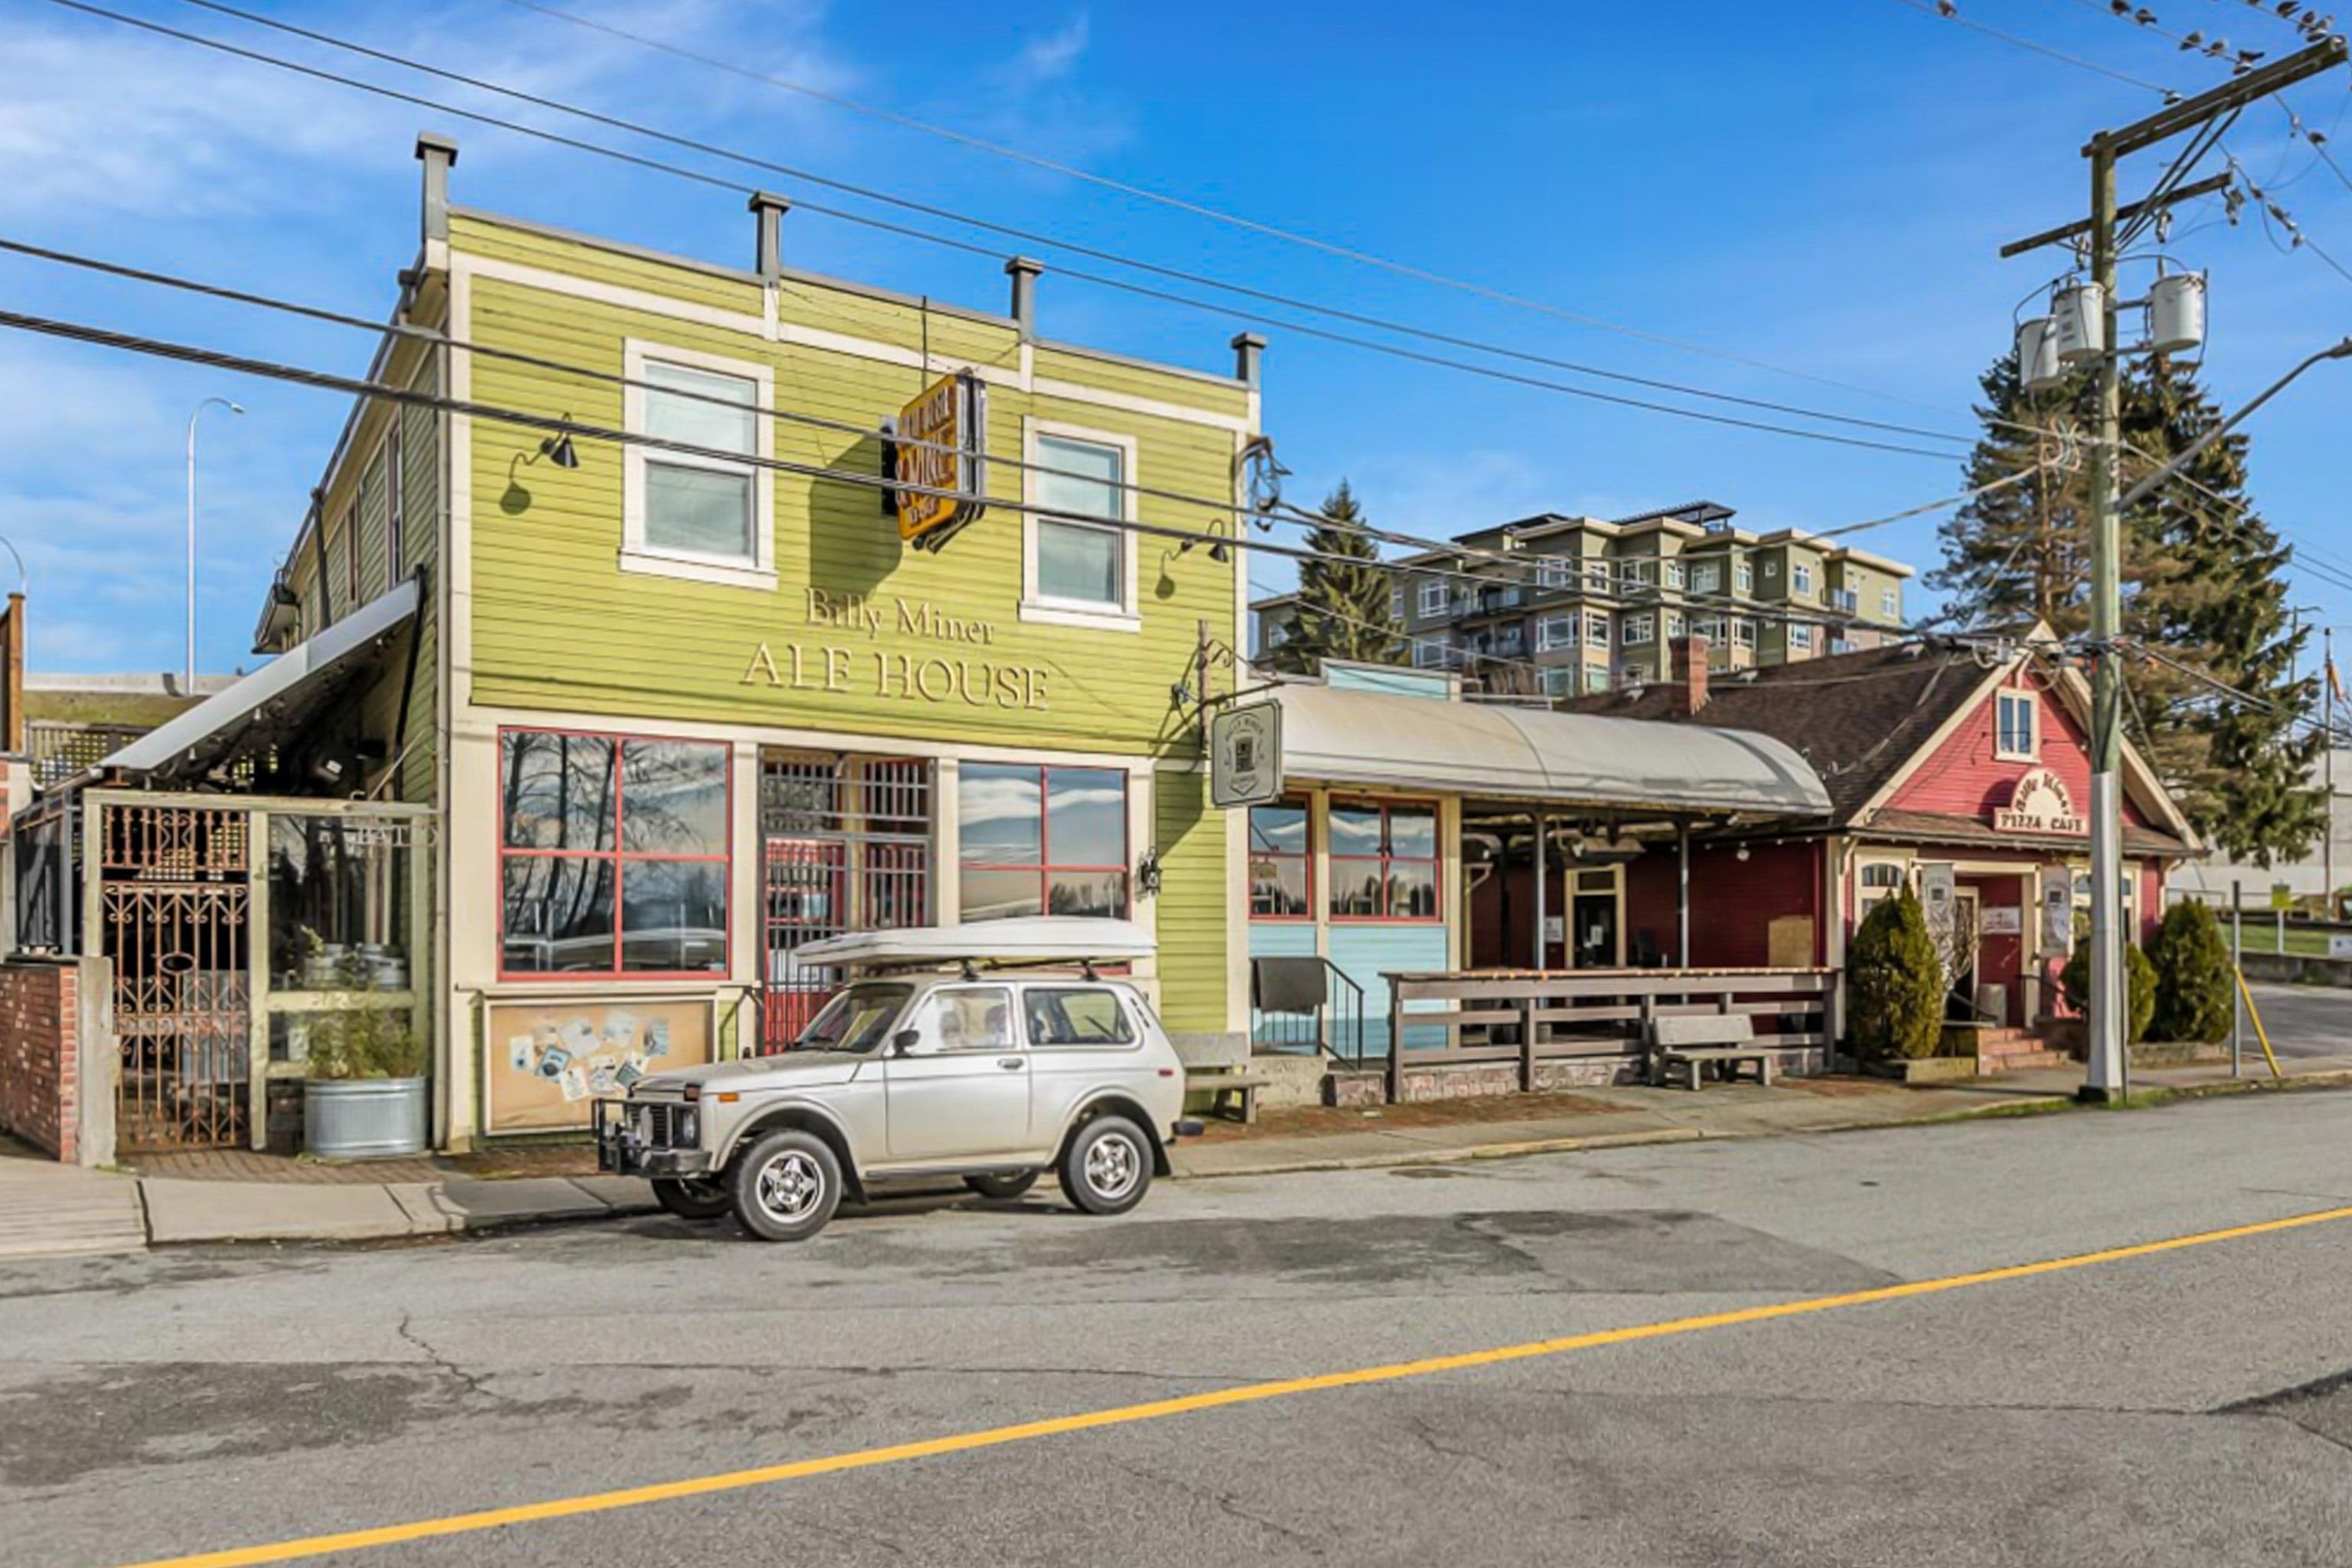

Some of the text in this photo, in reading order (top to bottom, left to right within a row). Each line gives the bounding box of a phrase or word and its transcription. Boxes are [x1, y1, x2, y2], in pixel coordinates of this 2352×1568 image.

[806, 587, 994, 645] Billy Miner
[739, 641, 1049, 712] ALE HOUSE
[2001, 814, 2041, 829] PIZZA
